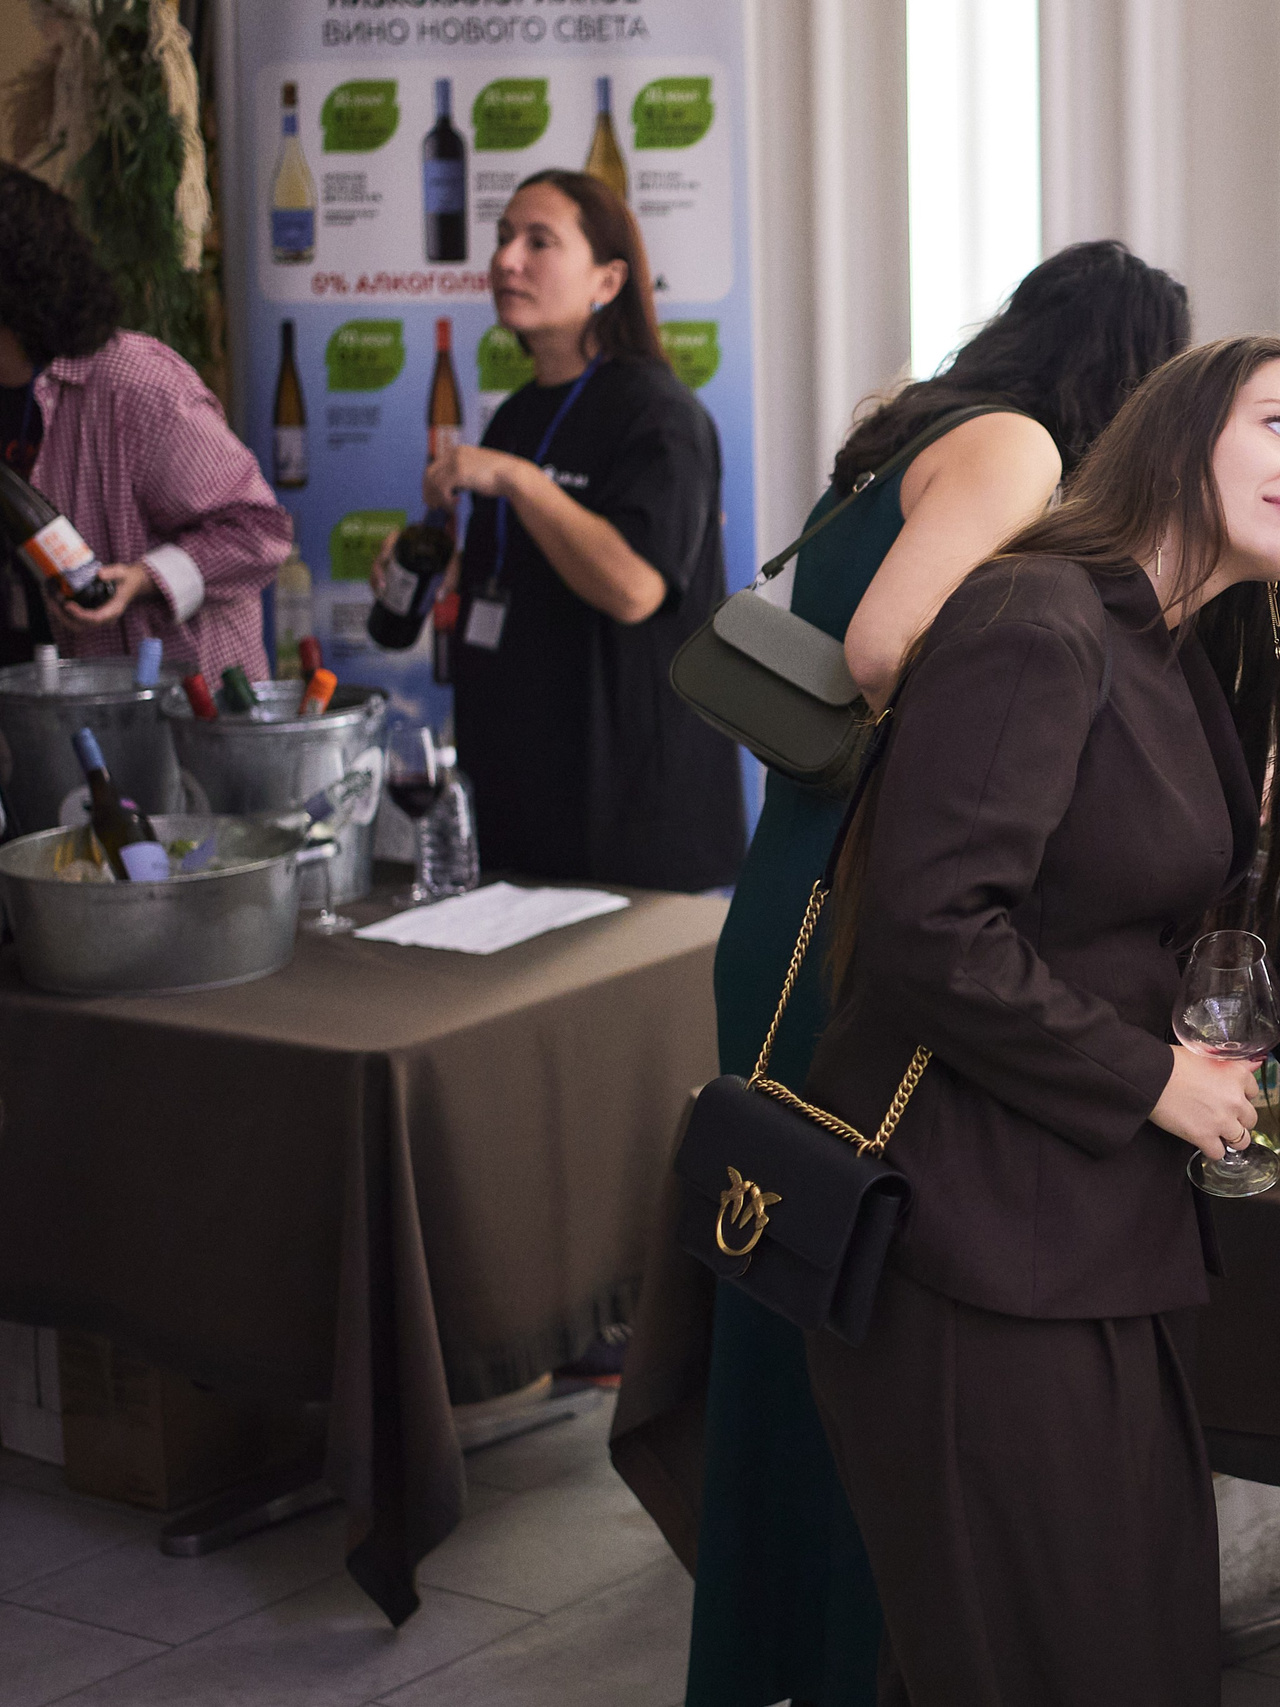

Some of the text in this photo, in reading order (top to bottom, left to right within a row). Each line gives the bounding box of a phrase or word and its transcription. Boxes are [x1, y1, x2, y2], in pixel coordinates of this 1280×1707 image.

[321, 13, 649, 46] ВИНО НОВОГО СВЕТА
[311, 271, 348, 294] 0%
